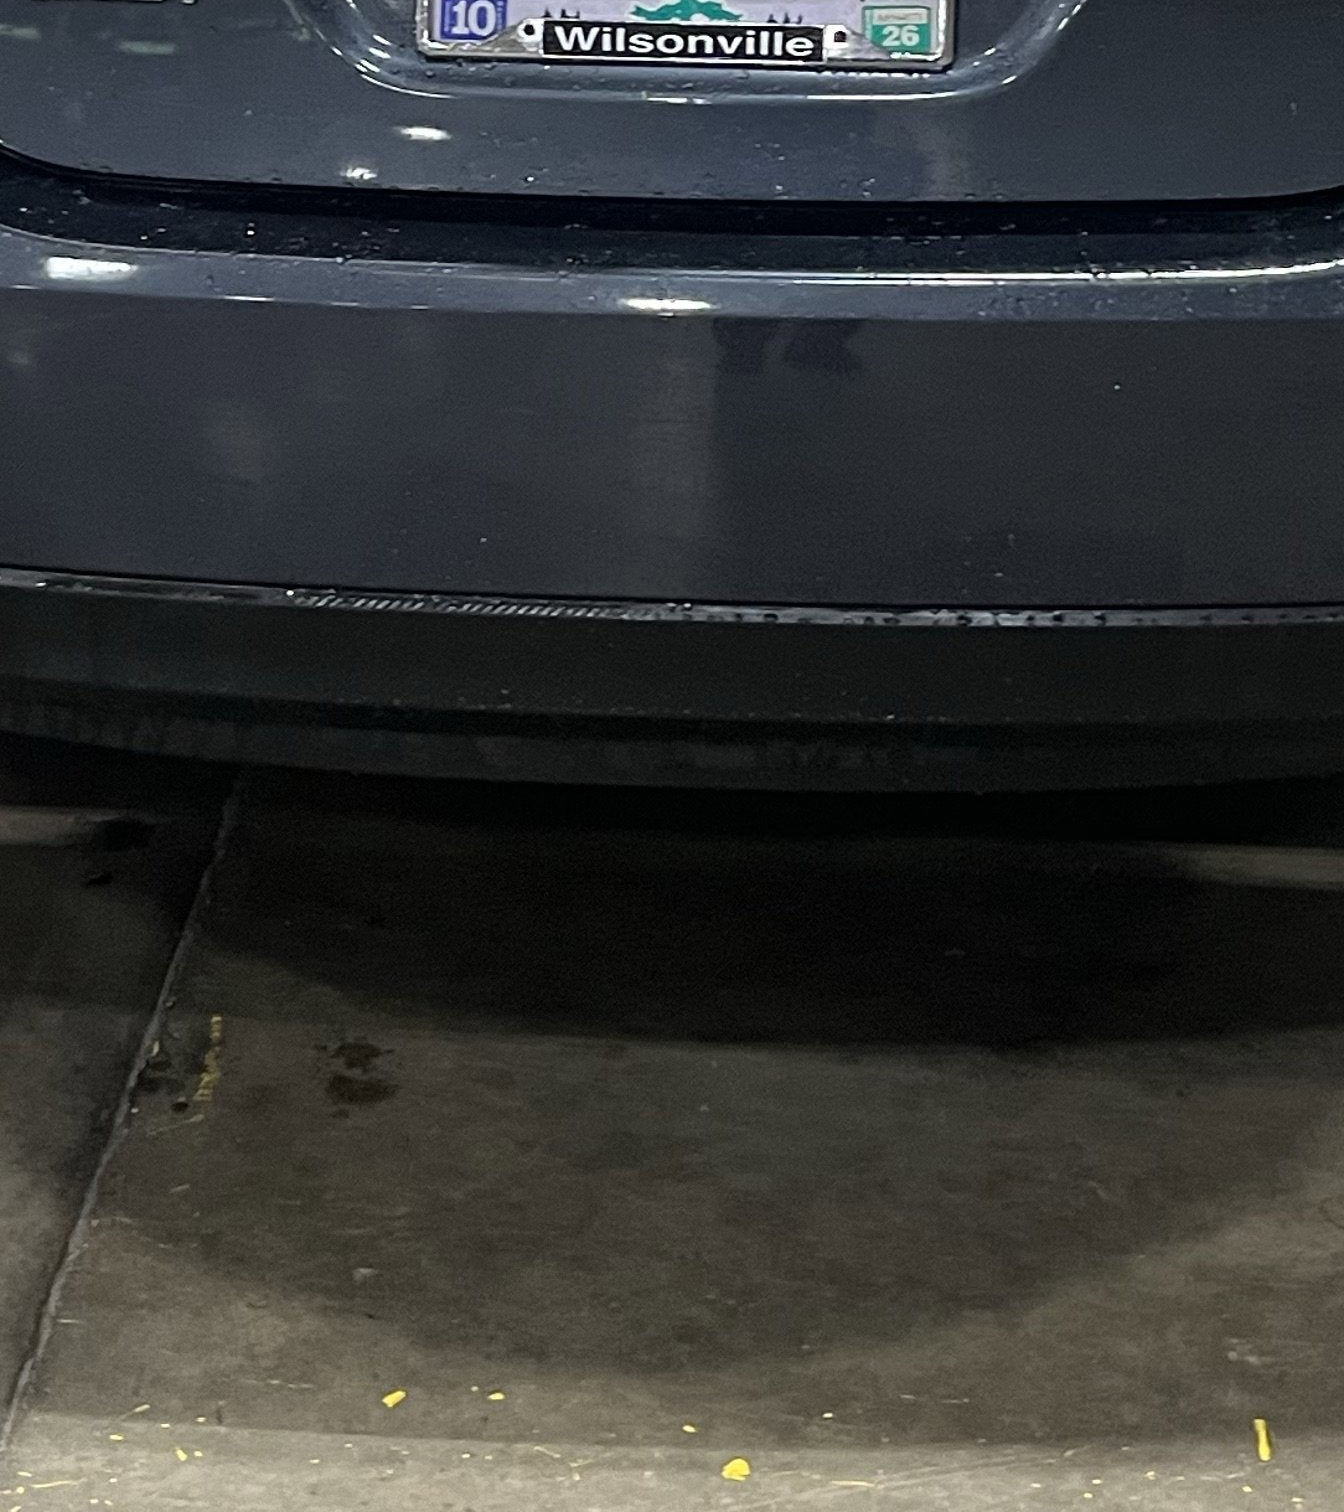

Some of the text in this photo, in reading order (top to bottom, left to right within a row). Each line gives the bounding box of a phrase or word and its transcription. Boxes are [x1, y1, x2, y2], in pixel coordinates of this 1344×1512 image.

[451, 0, 497, 37] 10
[555, 25, 815, 58] Wilsonville
[881, 24, 920, 47] 26
